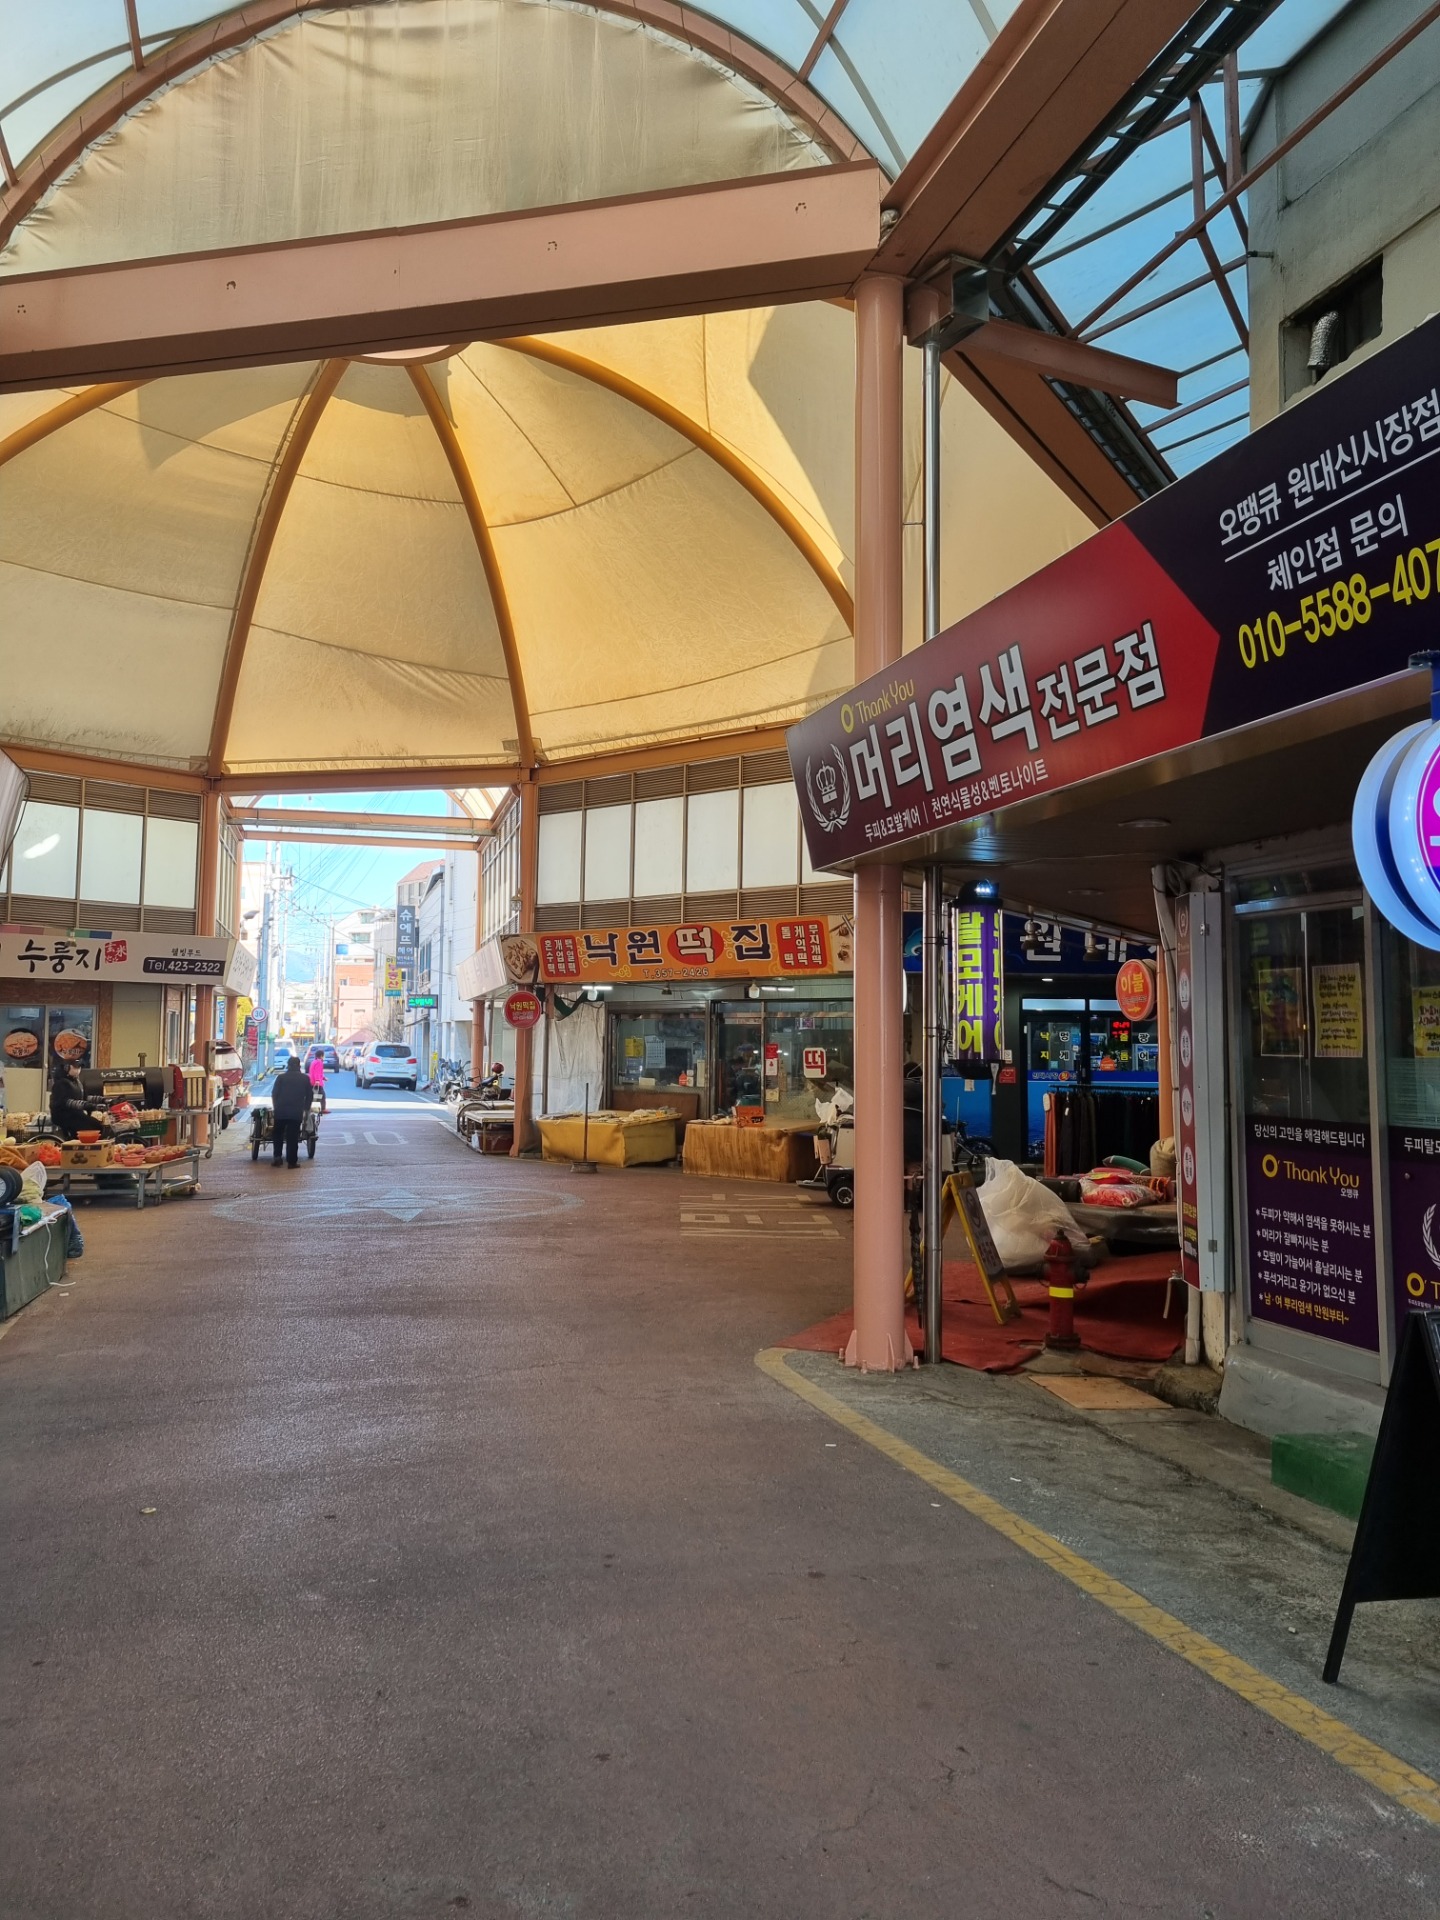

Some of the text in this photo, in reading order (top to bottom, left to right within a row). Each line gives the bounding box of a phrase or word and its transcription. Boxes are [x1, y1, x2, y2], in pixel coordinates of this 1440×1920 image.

[1219, 388, 1440, 546] 오땡큐 원대신시장점
[1267, 494, 1410, 592] 체인점 문의
[849, 619, 1166, 809] 머리염색 전문점
[855, 693, 892, 724] Thank
[889, 679, 915, 706] You
[17, 939, 102, 974] 누룽지
[794, 925, 808, 966] 케익떡
[808, 924, 823, 966] 무지개떡
[147, 959, 220, 974] Tel.423-2322
[642, 967, 709, 979] T.357-2426
[957, 911, 985, 1054] 탈모케어
[1120, 972, 1144, 995] 이불
[254, 1009, 264, 1018] 30
[1039, 1031, 1050, 1060] 낙지
[1059, 1031, 1070, 1061] 멍게
[1138, 1032, 1151, 1062] 광어
[804, 1050, 825, 1076] 떡
[1254, 1123, 1366, 1148] 당신의 고민을 해결해드립니다
[1283, 1160, 1328, 1185] Thank
[1329, 1166, 1360, 1188] You
[1261, 1207, 1372, 1239] 두피가 약해서 염색을 못하시는 분
[1262, 1228, 1330, 1254] 머리가 잘빠지시는 분
[1262, 1249, 1283, 1267] 모발이
[1284, 1254, 1313, 1273] 가늘어서
[1354, 1268, 1364, 1284] 분
[1263, 1270, 1357, 1305] 푸석거리고 윤기가 없으신 분
[1284, 1299, 1313, 1317] 뿌리염색
